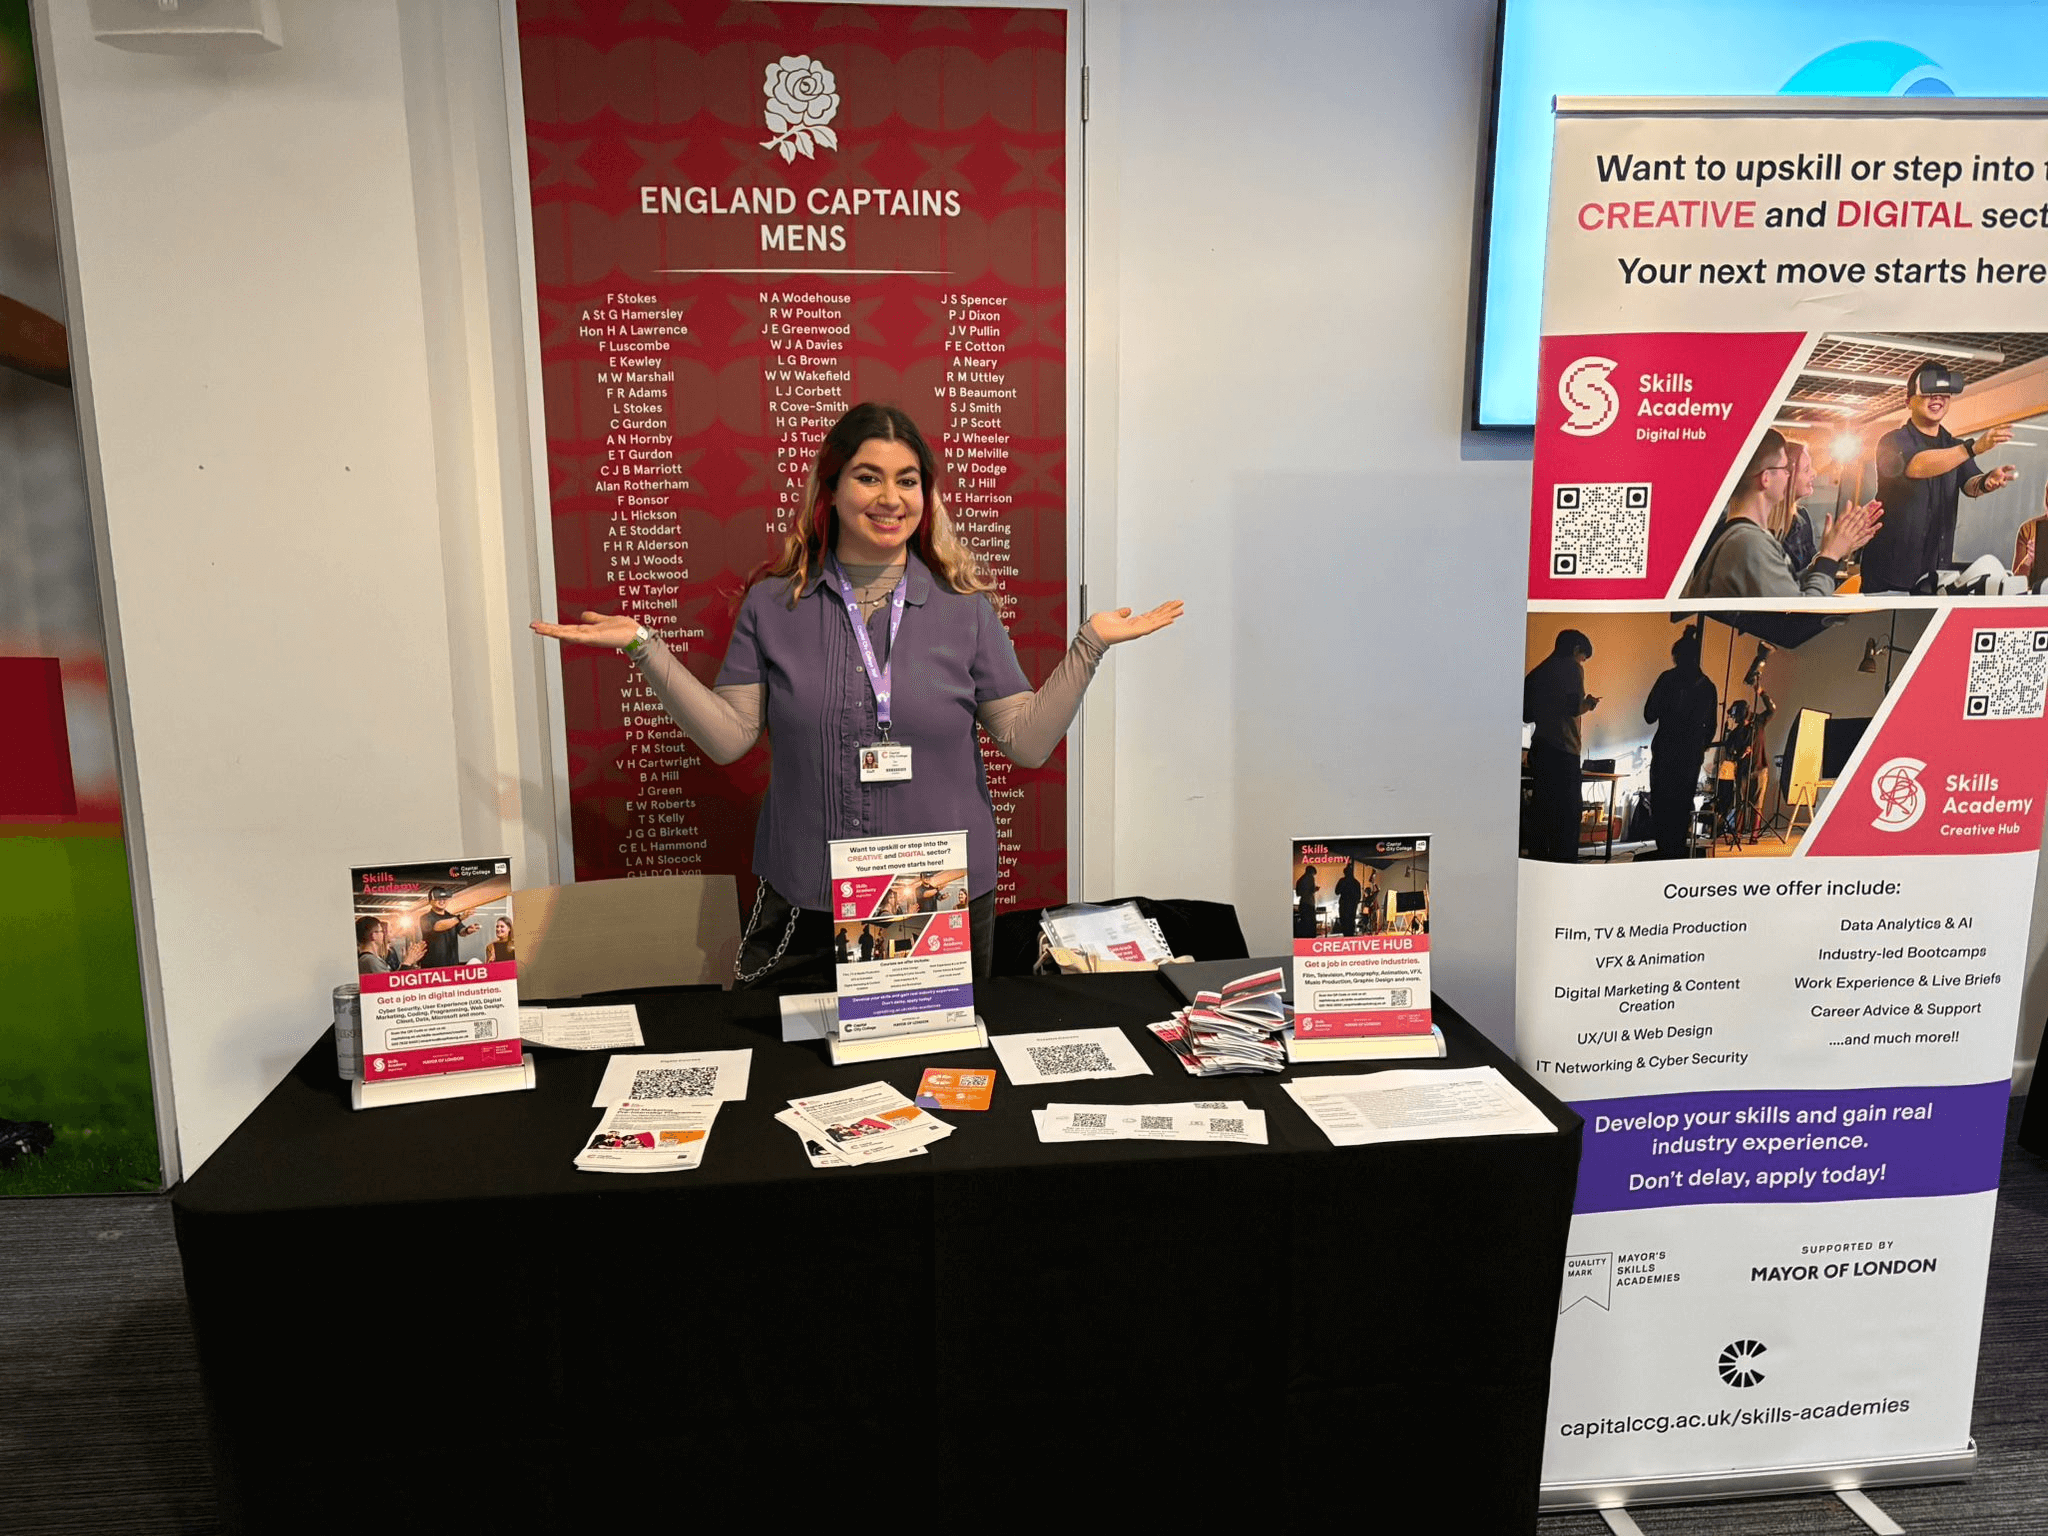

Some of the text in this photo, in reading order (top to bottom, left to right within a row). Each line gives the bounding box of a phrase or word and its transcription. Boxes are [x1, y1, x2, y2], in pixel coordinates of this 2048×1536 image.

[1597, 154, 1686, 182] Want
[1695, 155, 1726, 181] to
[1736, 154, 1842, 188] upskill
[1851, 160, 1886, 181] or
[1893, 156, 1962, 188] step
[1973, 155, 2034, 182] into
[641, 187, 961, 217] ENGLAND CAPTAINS
[1578, 201, 1756, 231] CREATIVE
[1765, 201, 1827, 228] and
[1837, 200, 1973, 228] DIGITAL
[761, 225, 846, 251] MENS
[1618, 258, 1692, 284] Your
[1700, 259, 1767, 284] next
[1777, 263, 1866, 283] move
[1874, 258, 1966, 284] starts
[608, 293, 657, 304] F Stokes
[760, 292, 851, 303] N A Wodehouse
[941, 294, 1008, 308] J S Spencer
[599, 340, 670, 352] F Luscombe
[610, 356, 662, 369] E Kewley
[953, 356, 997, 370] A Neary
[765, 370, 850, 381] W W Wakefield
[1639, 373, 1693, 393] Skills
[934, 387, 1017, 398] W B Beaumont
[614, 403, 663, 414] L Stokes
[769, 401, 849, 412] R Cove-Smith
[1637, 398, 1733, 420] Academy
[610, 419, 667, 429] C Gurdon
[1637, 428, 1706, 443] Digital Hub
[945, 448, 1009, 458] N D Melville
[595, 479, 689, 492] Alan Rotherham
[958, 478, 996, 488] R J Hill
[618, 495, 669, 506] F Bonsor
[956, 508, 999, 518] J Orwin
[622, 599, 677, 610] F Mitchell
[644, 614, 677, 626] Byrne
[1946, 774, 1998, 792] Skills
[638, 786, 682, 797] J Green
[1943, 796, 2033, 815] Academy
[638, 813, 685, 824] T S Kelly
[1940, 822, 2020, 836] Creative Hub
[1664, 880, 1901, 899] Courses we offer include:
[1555, 921, 1747, 942] Film, TV & Media Production
[1312, 938, 1413, 953] CREATIVE HUB
[1819, 947, 1986, 962] Industry-led Bootcamps
[389, 968, 488, 988] DIGITAL HUB
[1555, 979, 1740, 1002] Digital Marketing & Content
[1619, 999, 1675, 1013] Creation
[1874, 1032, 1911, 1044] much
[1915, 1031, 1959, 1043] more!!
[1596, 1103, 1933, 1133] Develop your skills and gain real
[1653, 1134, 1868, 1155] industry experience.
[1630, 1164, 1886, 1191] Don't delay, apply today!
[1802, 1241, 1893, 1255] SUPPORTED BY
[1568, 1258, 1607, 1268] QUALITY
[1618, 1251, 1666, 1263] MAYOR'S
[1568, 1269, 1592, 1277] MARK
[1617, 1264, 1655, 1275] SKILLS
[1751, 1258, 1937, 1281] MAYOR OF LONDON
[1616, 1273, 1680, 1287] ACADEMIES
[1561, 1398, 1909, 1439] capitalccg.ac.uk/skills-academies
